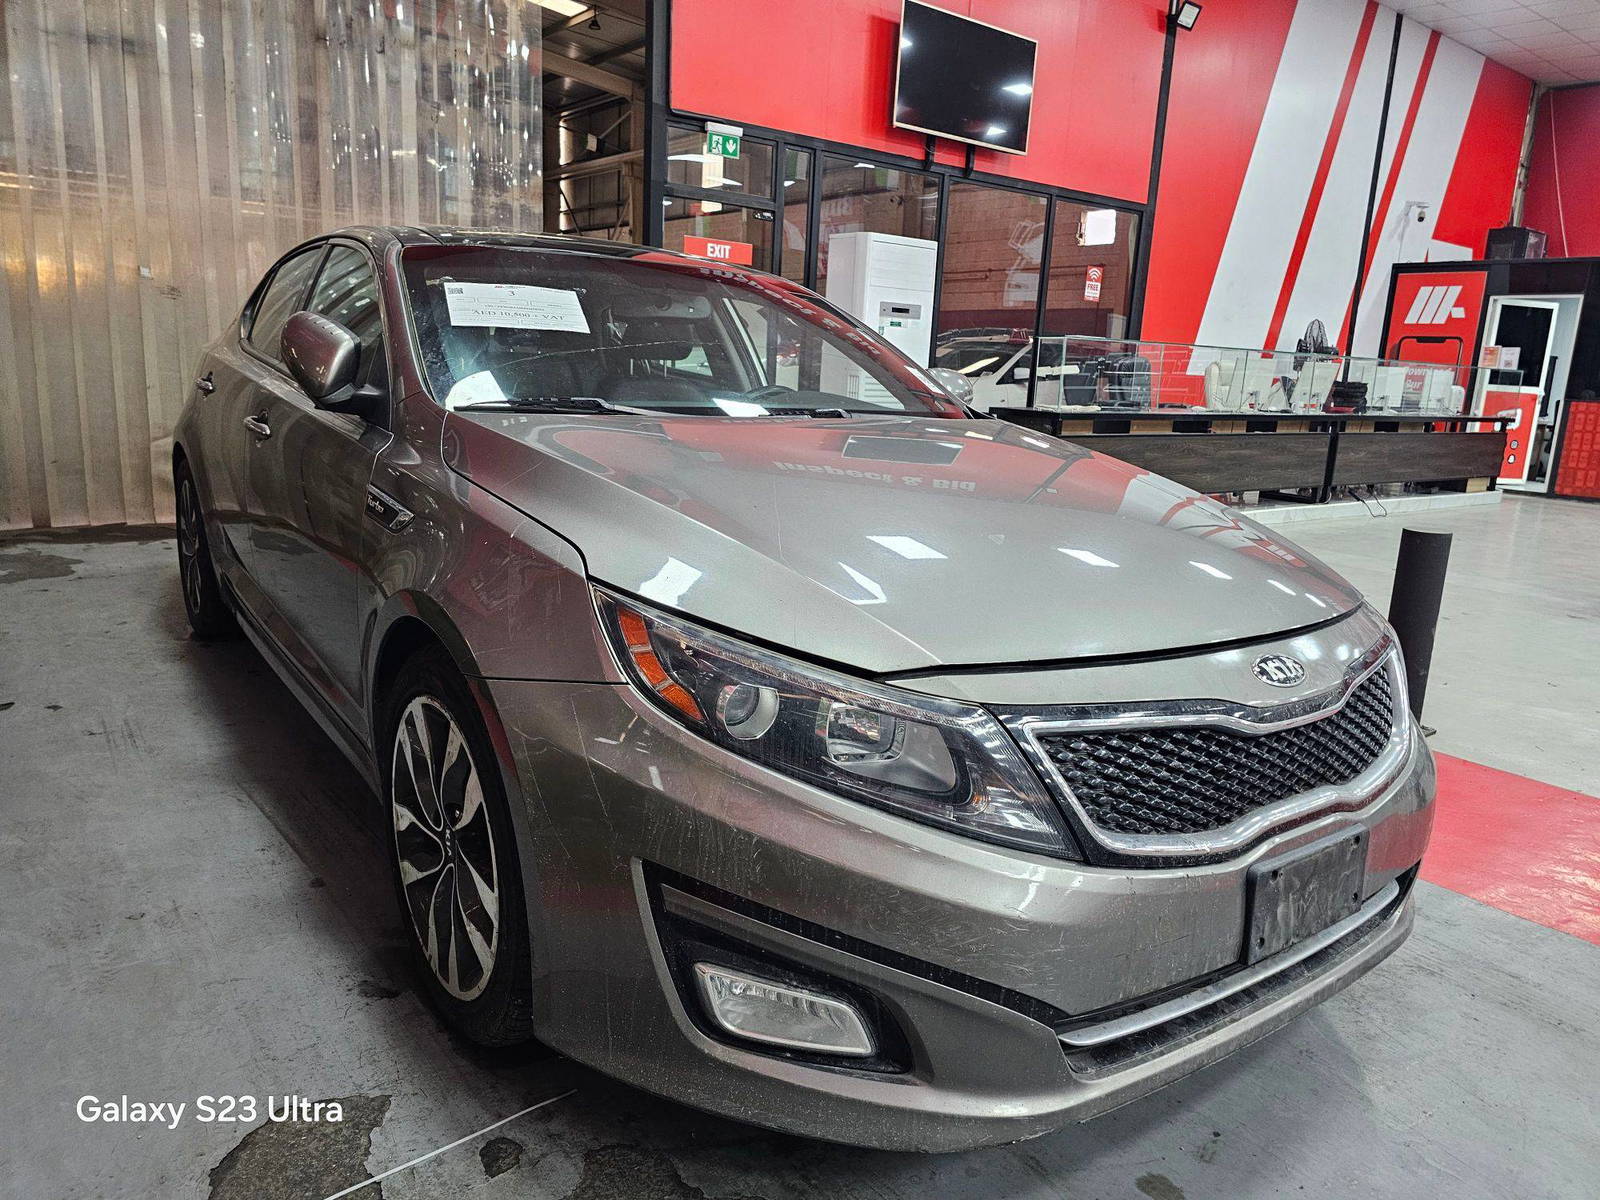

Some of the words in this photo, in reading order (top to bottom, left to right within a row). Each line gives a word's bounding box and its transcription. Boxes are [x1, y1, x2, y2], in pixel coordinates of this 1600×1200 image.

[706, 242, 731, 259] EXIT
[367, 495, 384, 513] Turbo
[1258, 656, 1303, 681] KIA
